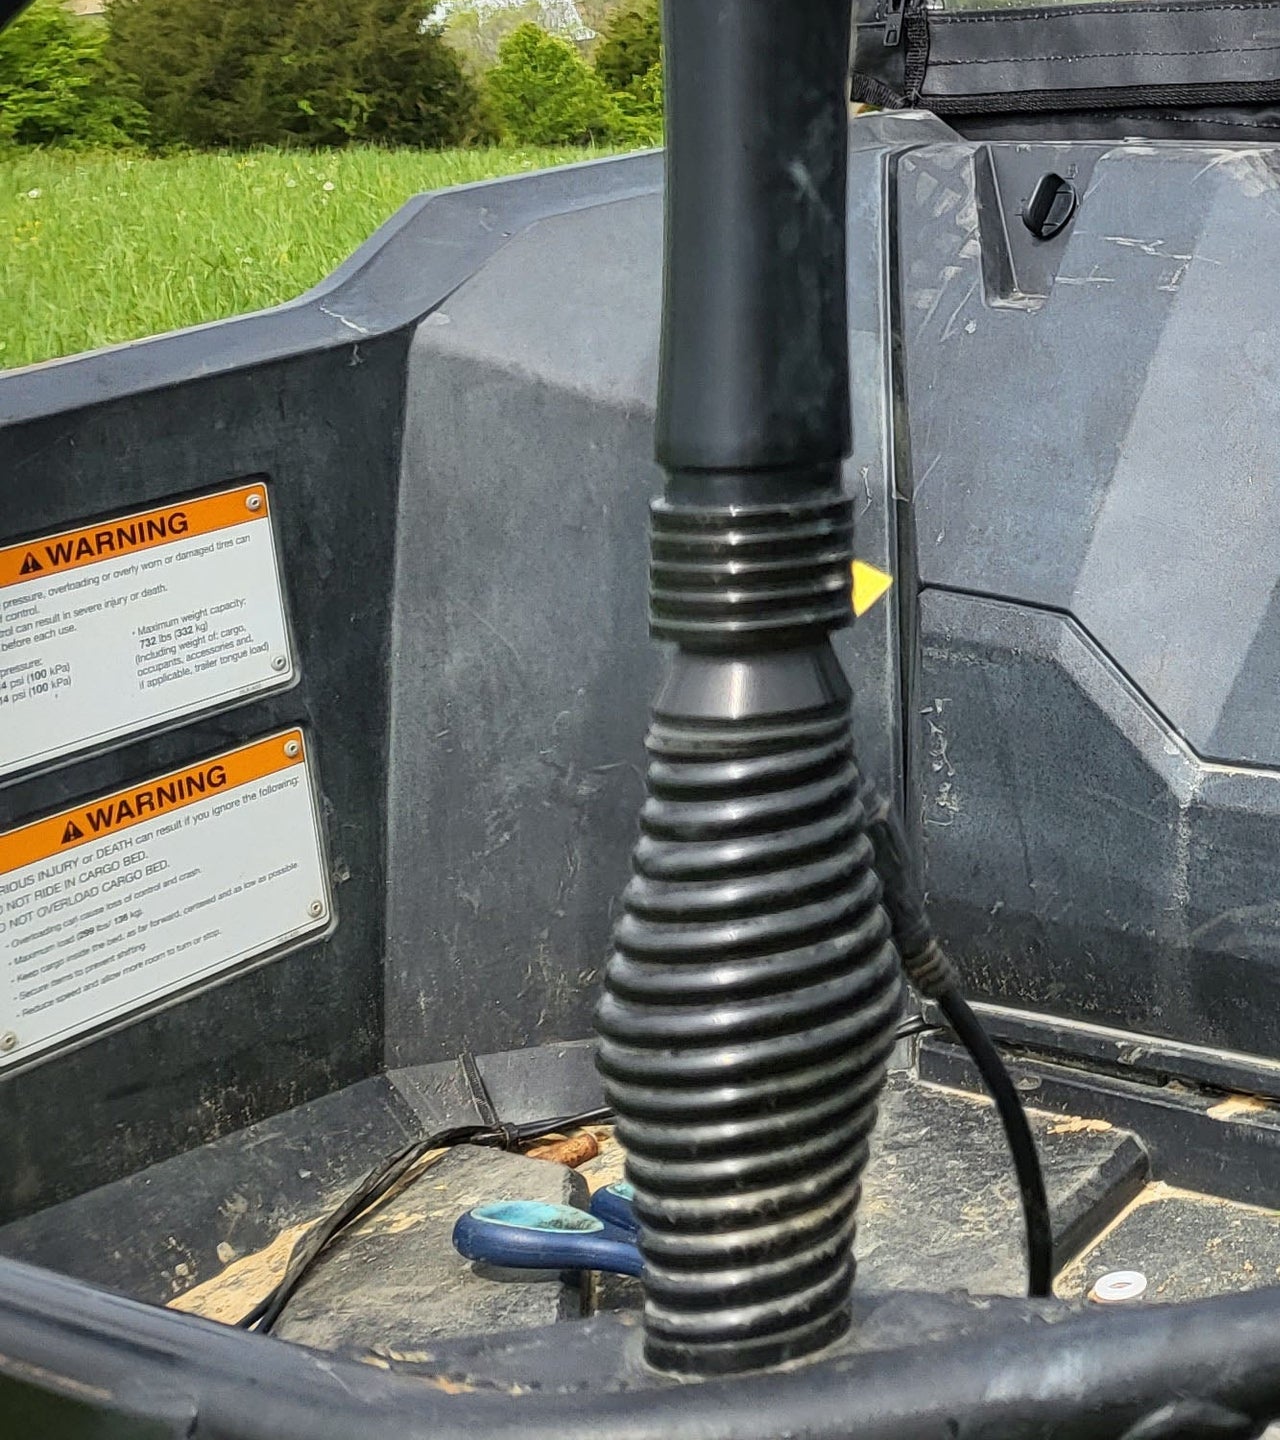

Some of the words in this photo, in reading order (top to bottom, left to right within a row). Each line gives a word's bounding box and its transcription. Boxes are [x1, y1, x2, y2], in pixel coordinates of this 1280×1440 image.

[45, 512, 188, 566] WARNING
[48, 575, 100, 596] overloading
[102, 573, 111, 582] or
[113, 563, 139, 579] overly
[141, 559, 163, 571] worn
[165, 555, 173, 564] or
[175, 543, 214, 562] damaged
[217, 538, 234, 550] tires
[236, 534, 251, 545] can
[5, 605, 40, 623] control.
[15, 621, 33, 634] can
[35, 613, 61, 628] result
[63, 611, 72, 620] in
[73, 602, 102, 617] severe
[104, 595, 128, 610] injury
[130, 590, 139, 599] or
[141, 583, 168, 598] death.
[137, 618, 178, 636] Maximum
[182, 608, 209, 625] weight
[1, 636, 32, 652] before
[33, 629, 56, 643] each
[58, 623, 77, 635] use.
[135, 643, 177, 665] (including
[178, 634, 207, 651] weight
[139, 636, 157, 650] 732
[158, 632, 172, 643] lbs
[174, 625, 194, 641] (332
[195, 620, 209, 634] kg)
[185, 641, 235, 662] accessories
[10, 676, 25, 690] psi
[26, 668, 47, 684] (100
[49, 662, 71, 676] kPa)
[12, 690, 26, 704] psi
[28, 681, 49, 698] (100
[51, 675, 72, 689] kPa)
[138, 679, 145, 690] if
[194, 658, 218, 673] trailer
[220, 651, 248, 668] tongue
[249, 641, 270, 655] load)
[86, 765, 226, 832] WARNING
[38, 857, 79, 881] INJURY
[82, 854, 94, 865] or
[96, 838, 133, 859] DEATH
[135, 830, 154, 844] can
[156, 819, 183, 837] result
[184, 815, 191, 826] if
[192, 811, 209, 826] you
[211, 799, 240, 818] ignore
[242, 791, 257, 804] the
[258, 775, 300, 797] following:
[6, 894, 32, 911] NOT
[34, 882, 62, 901] RIDE
[65, 877, 76, 889] IN
[79, 861, 120, 884] CARGO
[123, 850, 149, 867] BED.
[9, 911, 34, 928] NOT
[36, 886, 99, 918] OVERLOAD
[102, 869, 142, 892] CARGO
[145, 859, 170, 877] BED.
[11, 923, 62, 948] Overloading
[80, 906, 104, 921] cause
[106, 899, 122, 910] loss
[124, 893, 132, 903] of
[134, 883, 161, 899] control
[163, 876, 177, 888] and
[40, 958, 65, 974] cargo
[92, 942, 105, 952] the
[126, 929, 137, 938] as
[138, 923, 148, 933] far
[218, 888, 232, 900] and
[258, 875, 267, 884] as
[74, 969, 84, 977] to
[83, 979, 99, 991] and
[101, 971, 121, 985] allow
[123, 962, 144, 975] more
[145, 952, 166, 966] room
[167, 947, 176, 956] to
[176, 941, 192, 952] turn
[193, 937, 202, 945] or
